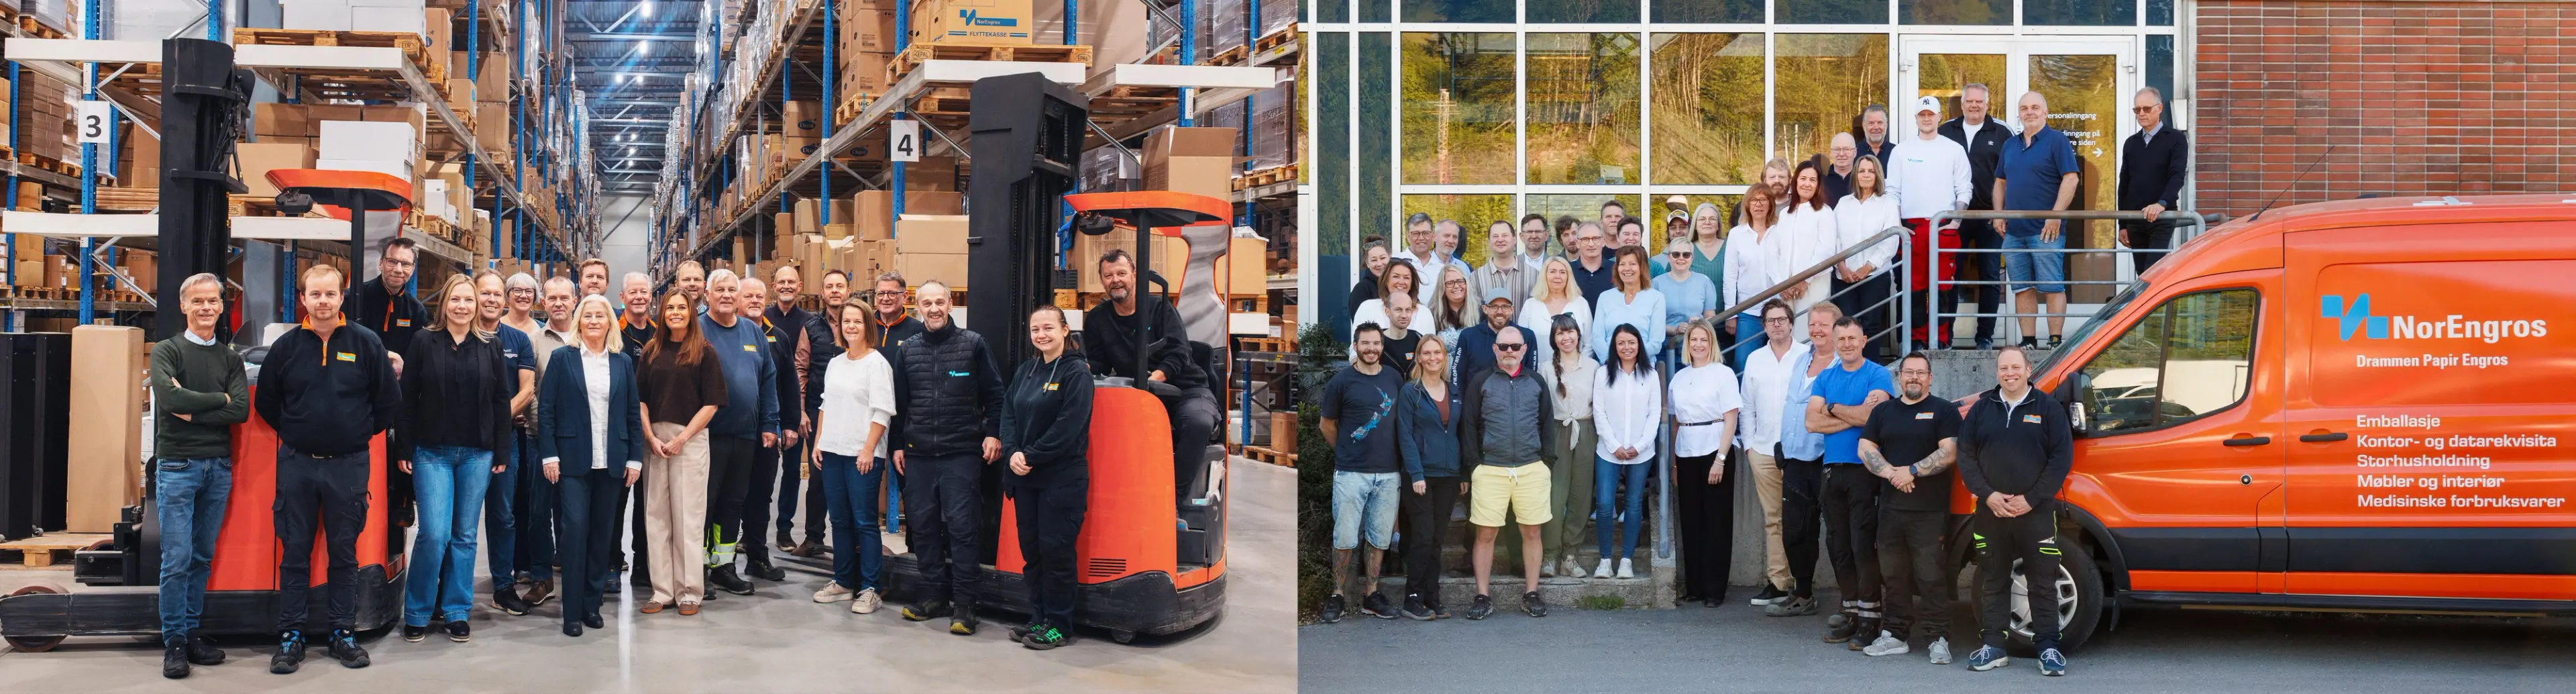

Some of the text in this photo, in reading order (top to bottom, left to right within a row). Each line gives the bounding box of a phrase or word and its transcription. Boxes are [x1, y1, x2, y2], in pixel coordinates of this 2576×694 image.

[2047, 112, 2097, 120] ersonalinngang
[86, 115, 102, 138] 3
[2092, 130, 2101, 138] på
[898, 134, 913, 156] 4
[2393, 315, 2546, 344] NorEngros
[2356, 353, 2508, 369] Drammen Papir Engros
[2357, 415, 2440, 430] Emballasje
[2357, 434, 2557, 450] Kontor- og datarekvisita
[2357, 454, 2490, 469] Storhusholdning
[2357, 475, 2505, 490] Møbler og interiør
[2358, 495, 2565, 507] Medisinske forbruksvarer
